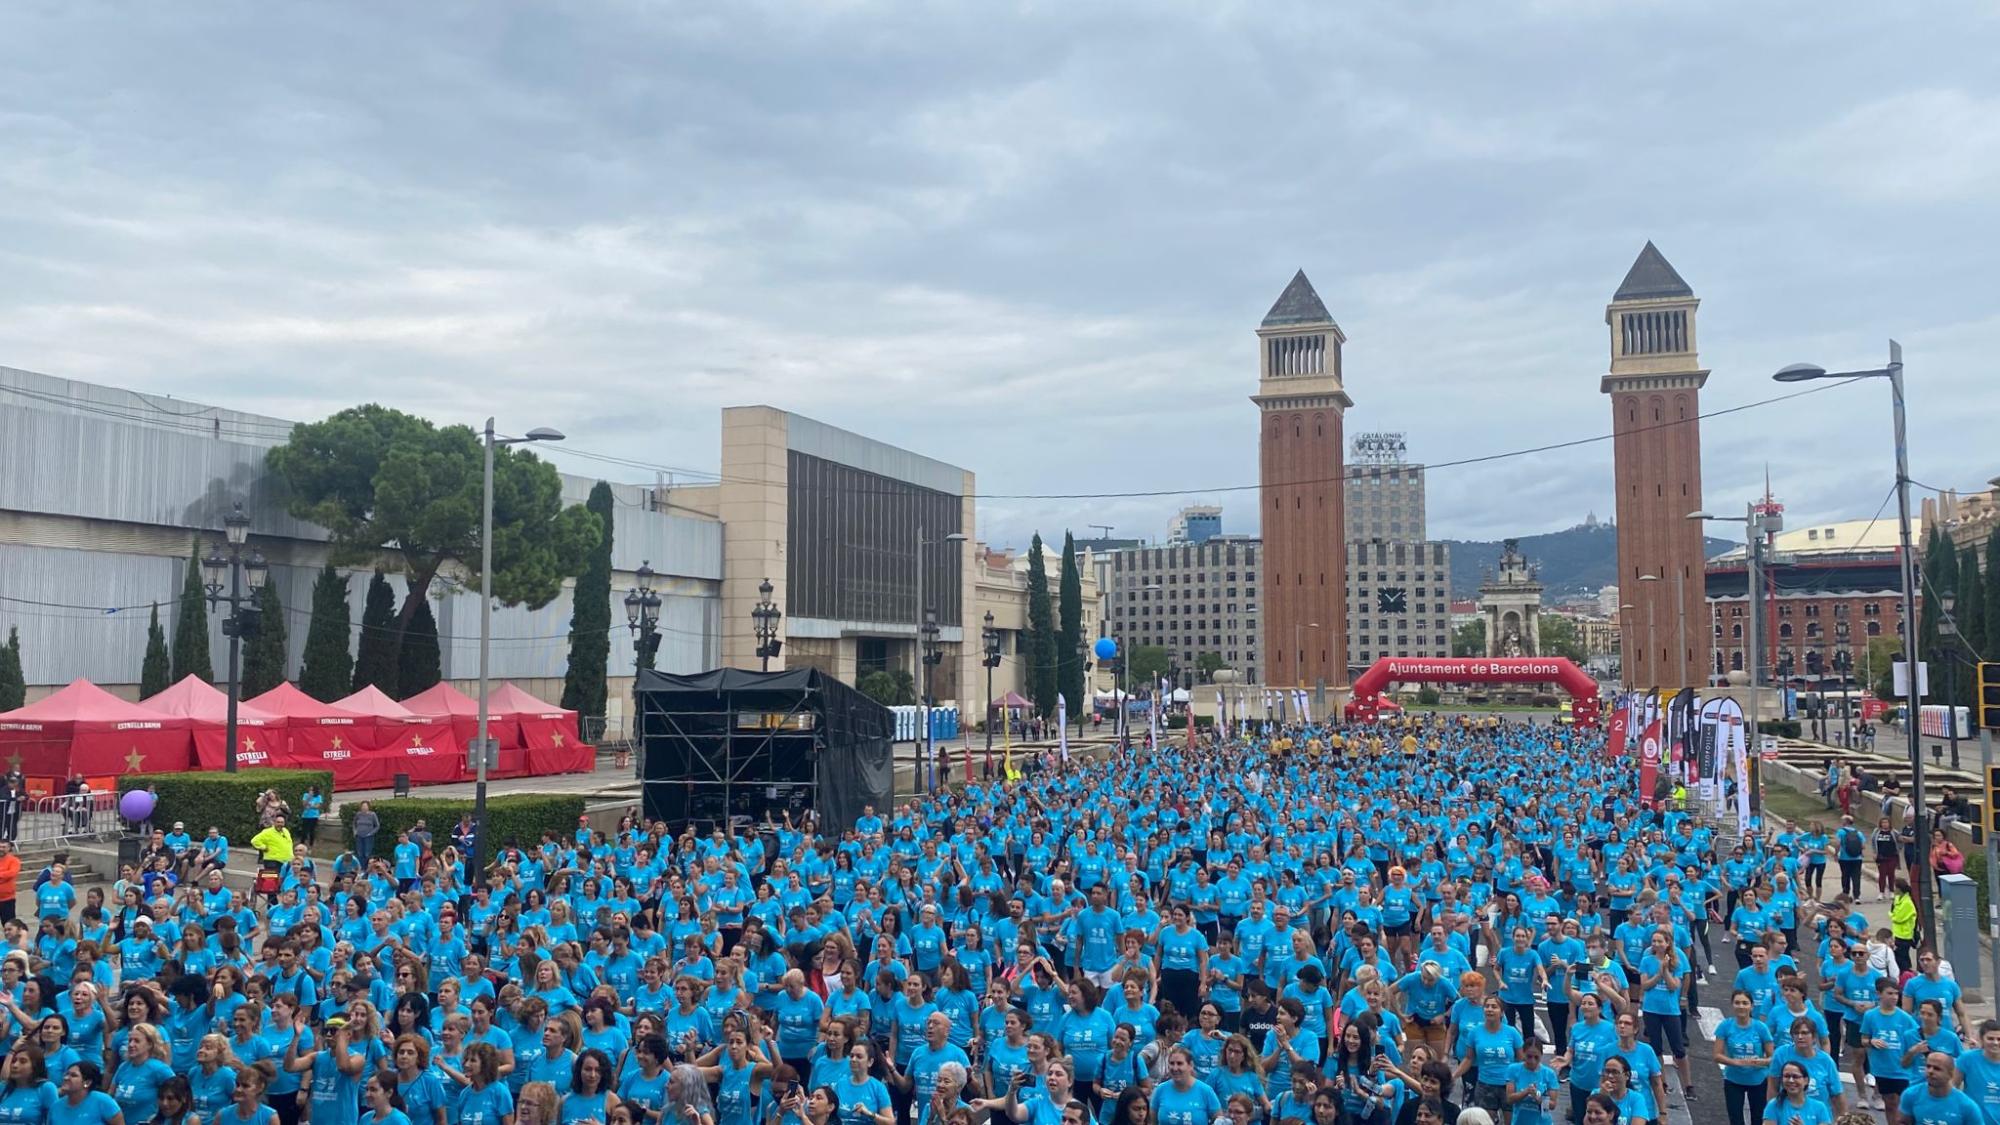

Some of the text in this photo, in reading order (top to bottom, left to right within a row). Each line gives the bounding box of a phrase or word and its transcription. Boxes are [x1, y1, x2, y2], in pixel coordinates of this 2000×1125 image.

[1358, 441, 1406, 450] PLAZA
[1388, 662, 1559, 676] Ajuntament de Barcelona
[1614, 720, 1624, 731] 2
[237, 751, 268, 761] ESTRELLA
[323, 750, 351, 759] ESTRELLA
